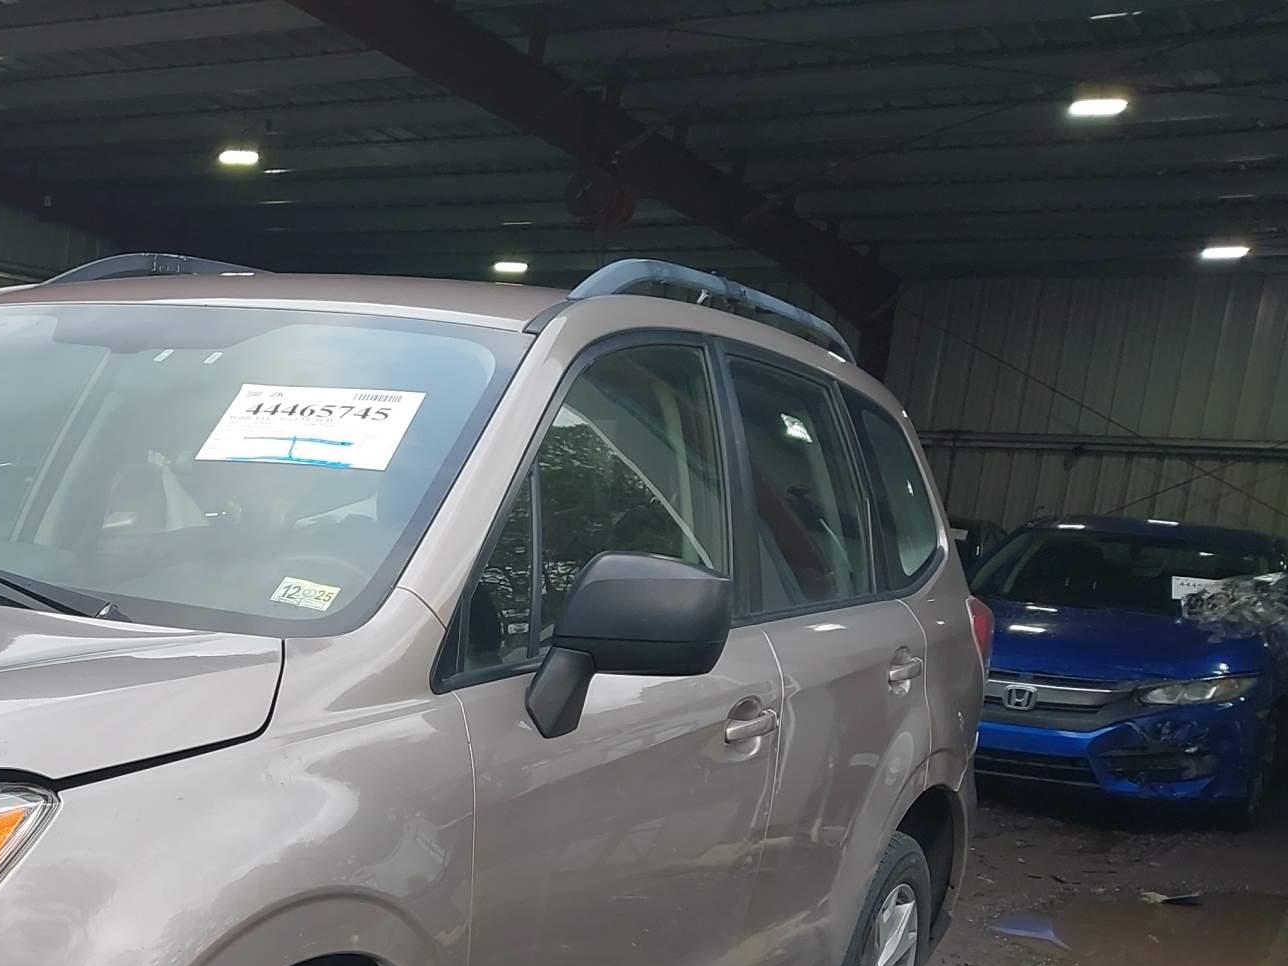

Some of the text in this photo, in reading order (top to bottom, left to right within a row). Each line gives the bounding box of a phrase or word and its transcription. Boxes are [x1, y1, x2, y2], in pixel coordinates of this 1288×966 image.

[246, 402, 392, 421] 44465745
[280, 584, 334, 602] 12 25
